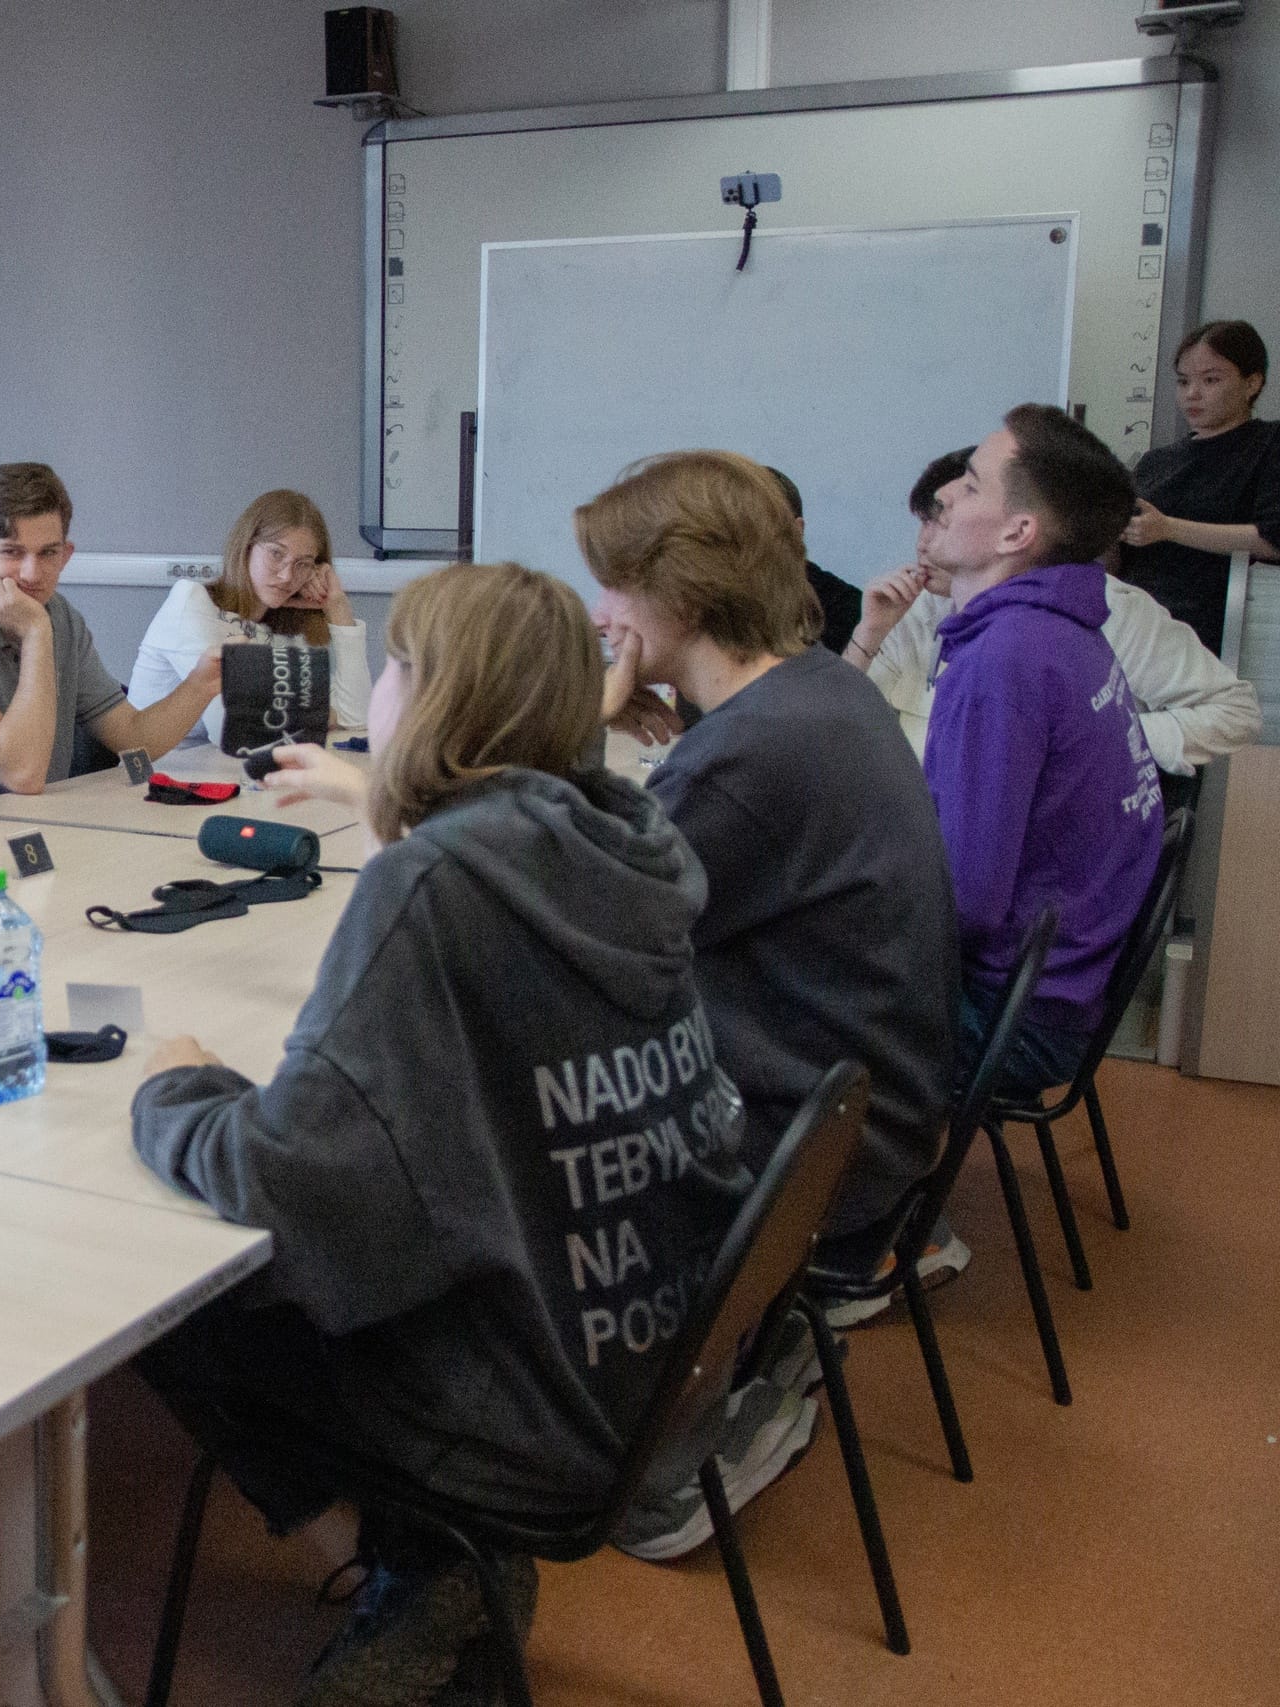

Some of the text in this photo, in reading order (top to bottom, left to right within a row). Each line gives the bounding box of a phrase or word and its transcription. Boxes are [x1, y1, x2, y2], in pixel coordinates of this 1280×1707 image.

[298, 654, 312, 707] MASONS
[24, 843, 38, 865] 8
[534, 1038, 671, 1129] NADO
[566, 1219, 651, 1291] NA
